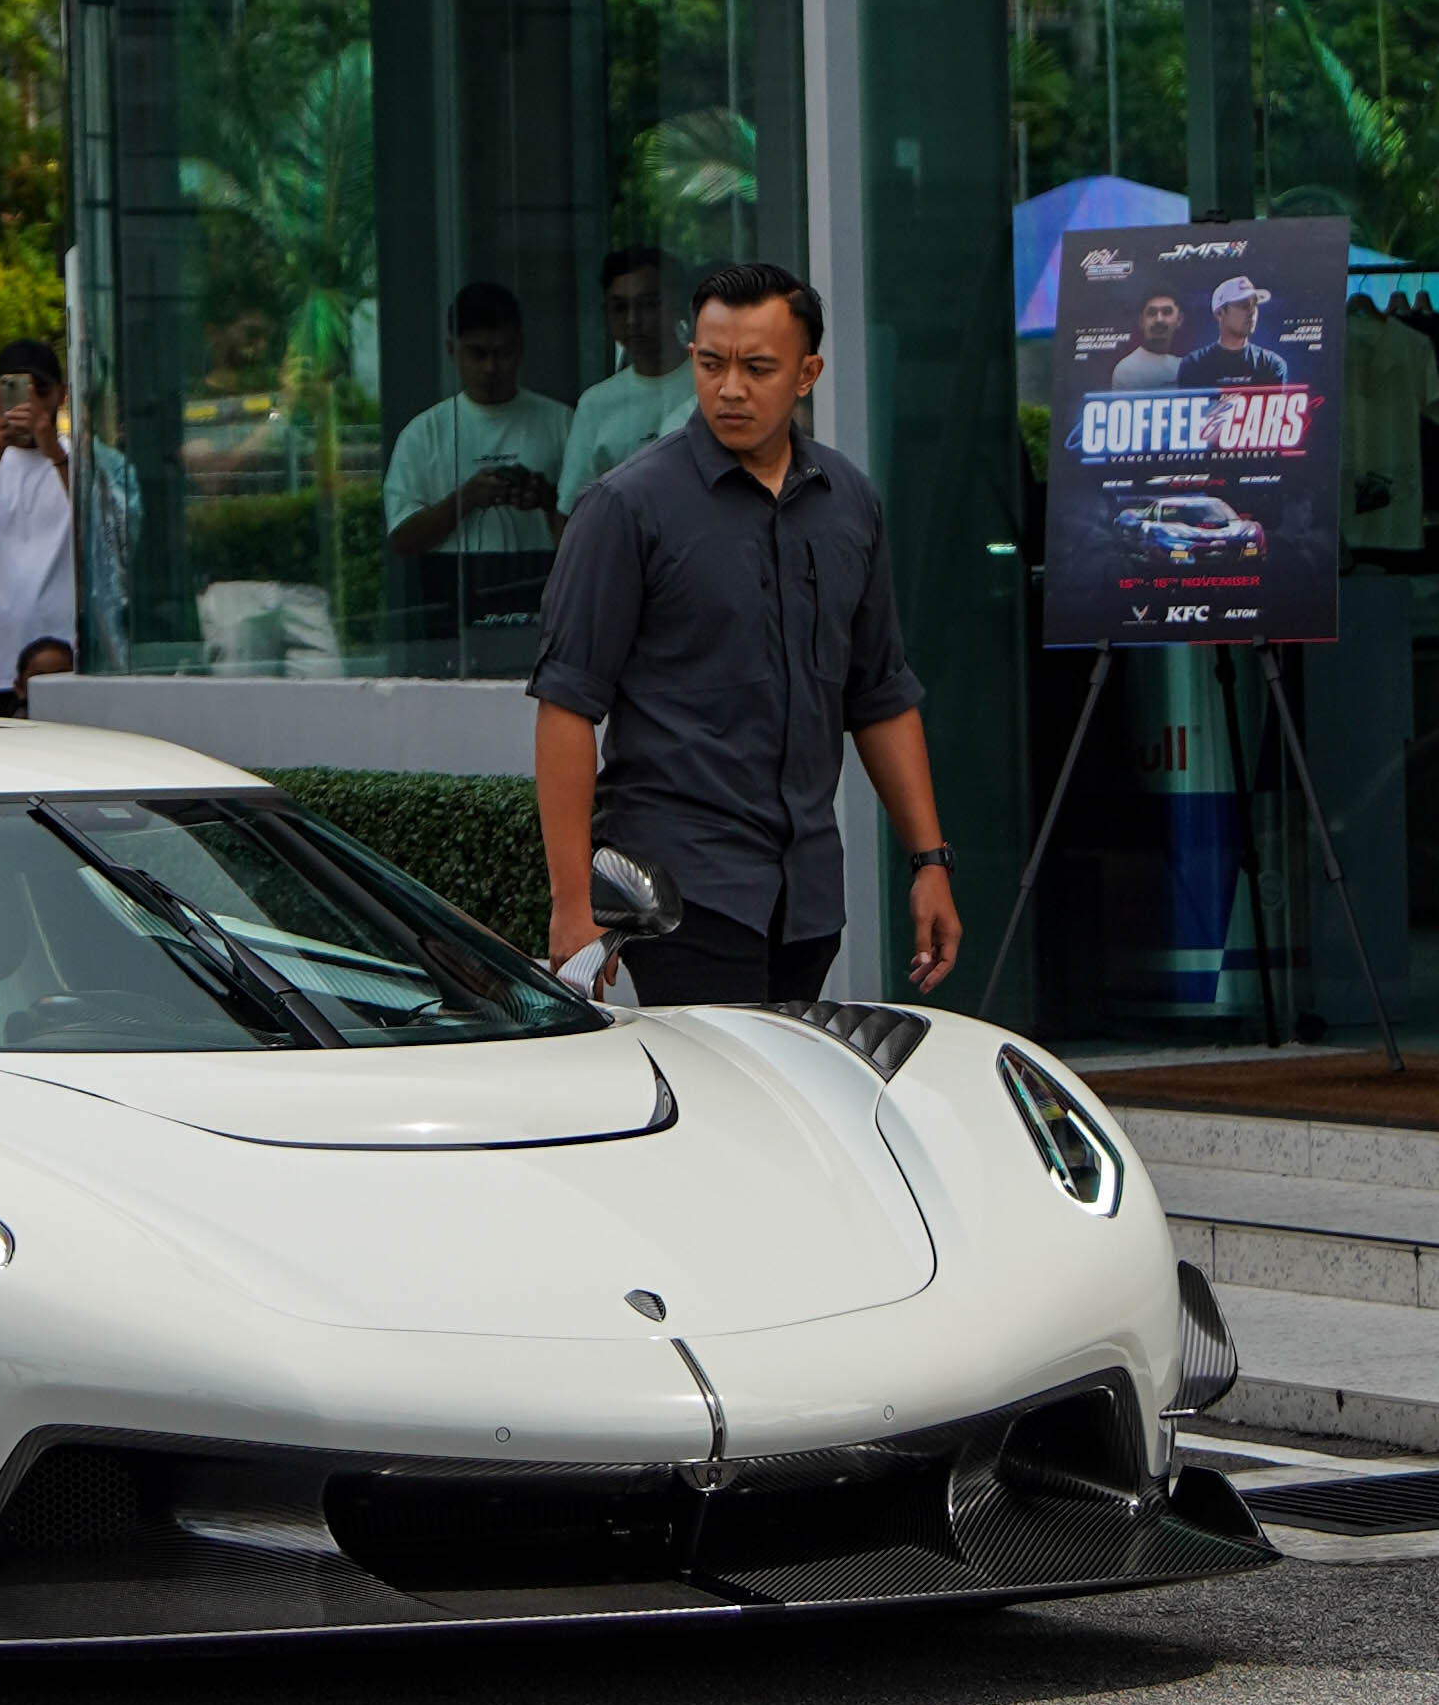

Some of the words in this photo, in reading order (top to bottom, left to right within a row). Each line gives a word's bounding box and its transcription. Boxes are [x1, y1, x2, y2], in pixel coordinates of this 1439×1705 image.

[1081, 397, 1210, 454] COFFEE
[1218, 393, 1308, 450] CARS
[1111, 455, 1152, 463] VAMOS
[1158, 453, 1205, 462] COFFEE
[1211, 450, 1277, 460] ROASTERY
[1181, 575, 1260, 588] NOVEMBER
[1165, 605, 1210, 623] KFC
[1224, 608, 1258, 619] ALTON
